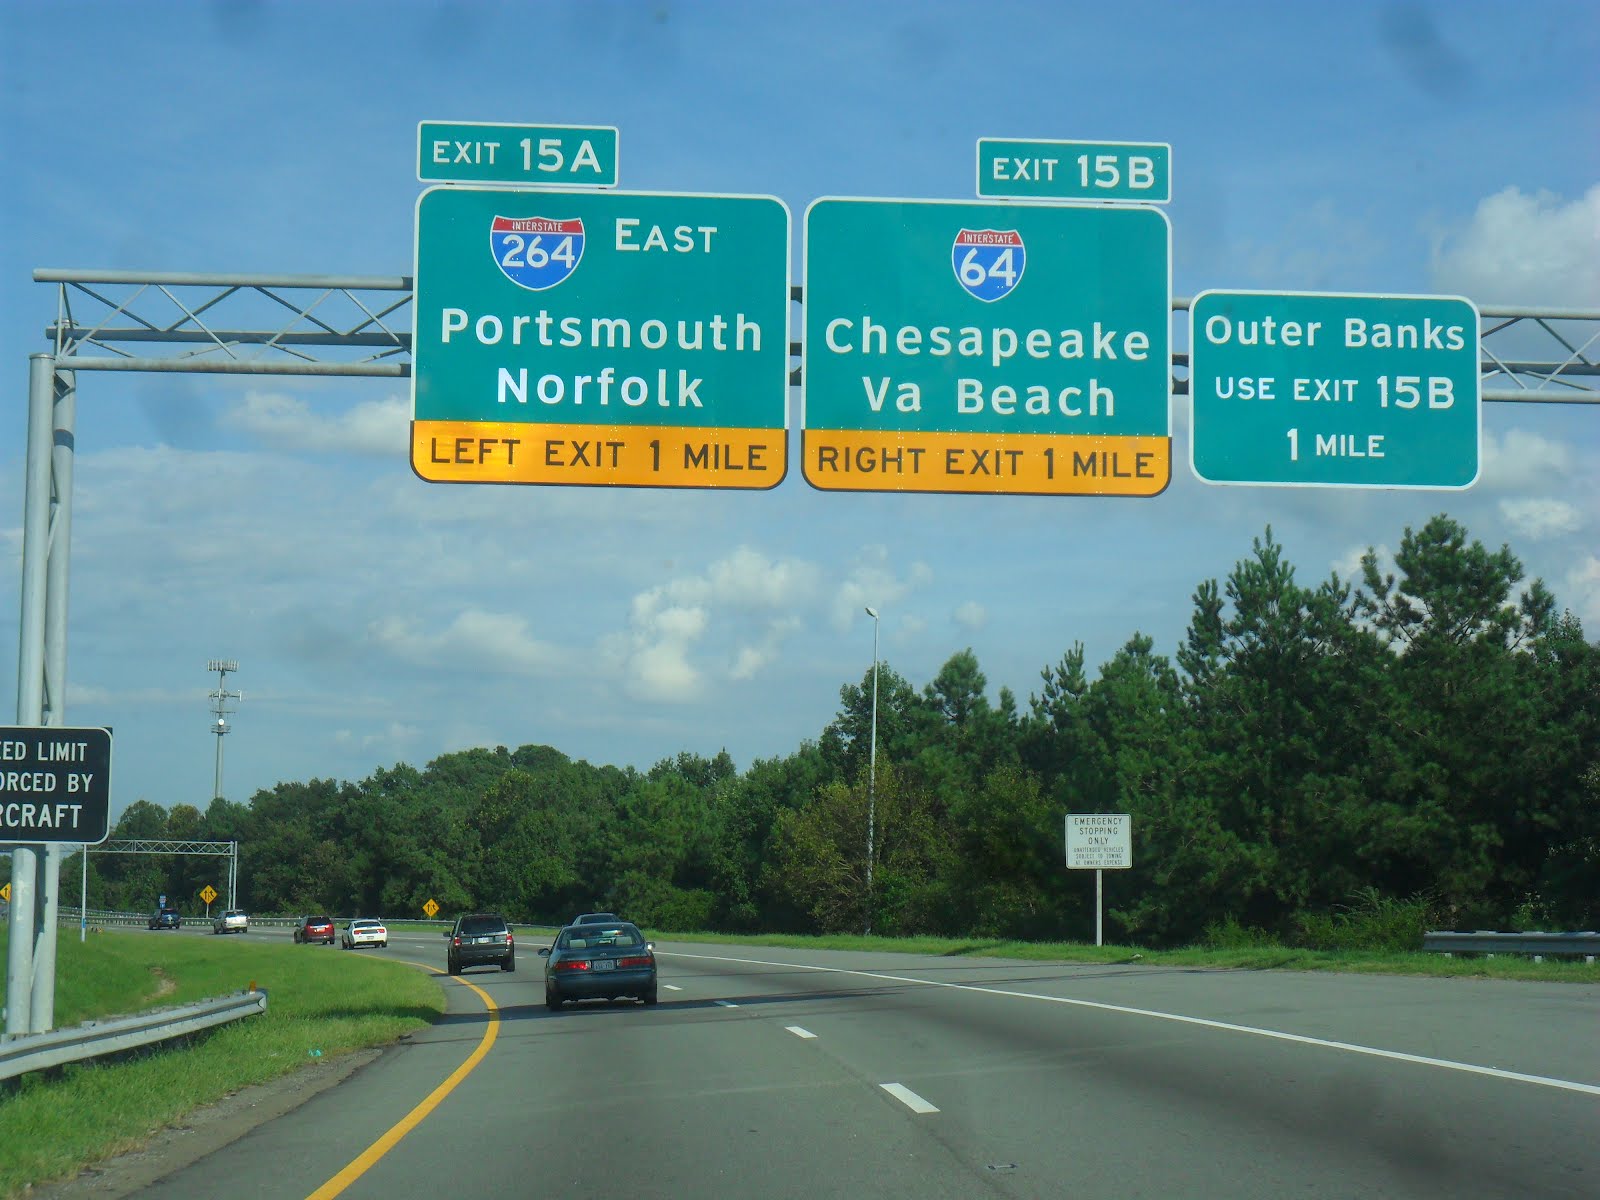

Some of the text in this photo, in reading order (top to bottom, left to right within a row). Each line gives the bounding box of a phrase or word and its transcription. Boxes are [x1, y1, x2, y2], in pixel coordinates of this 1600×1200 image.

[433, 138, 602, 172] EXIT 15A
[993, 155, 1155, 189] EXIT 15B
[511, 220, 563, 232] INTERSTATE
[616, 218, 718, 252] EAST
[963, 232, 1014, 244] INTERSTATE
[502, 234, 575, 269] 264
[960, 248, 1016, 287] 64
[442, 308, 761, 351] Portsmouth
[825, 316, 1149, 366] Chesapeake
[1205, 315, 1464, 350] Outer Banks
[498, 368, 704, 407] Norfolk
[862, 376, 1114, 416] Va Beach
[1216, 375, 1454, 409] USE EXIT 15B
[431, 437, 767, 471] LEFT EXIT 1 MILE
[1287, 429, 1385, 461] 1 MILE
[819, 447, 1154, 479] RIGHT EXIT 1 MILE
[0, 741, 87, 761] ED LIMIT
[68, 774, 93, 792] BY
[0, 803, 82, 828] CRAFT
[1088, 837, 1109, 845] ONLY
